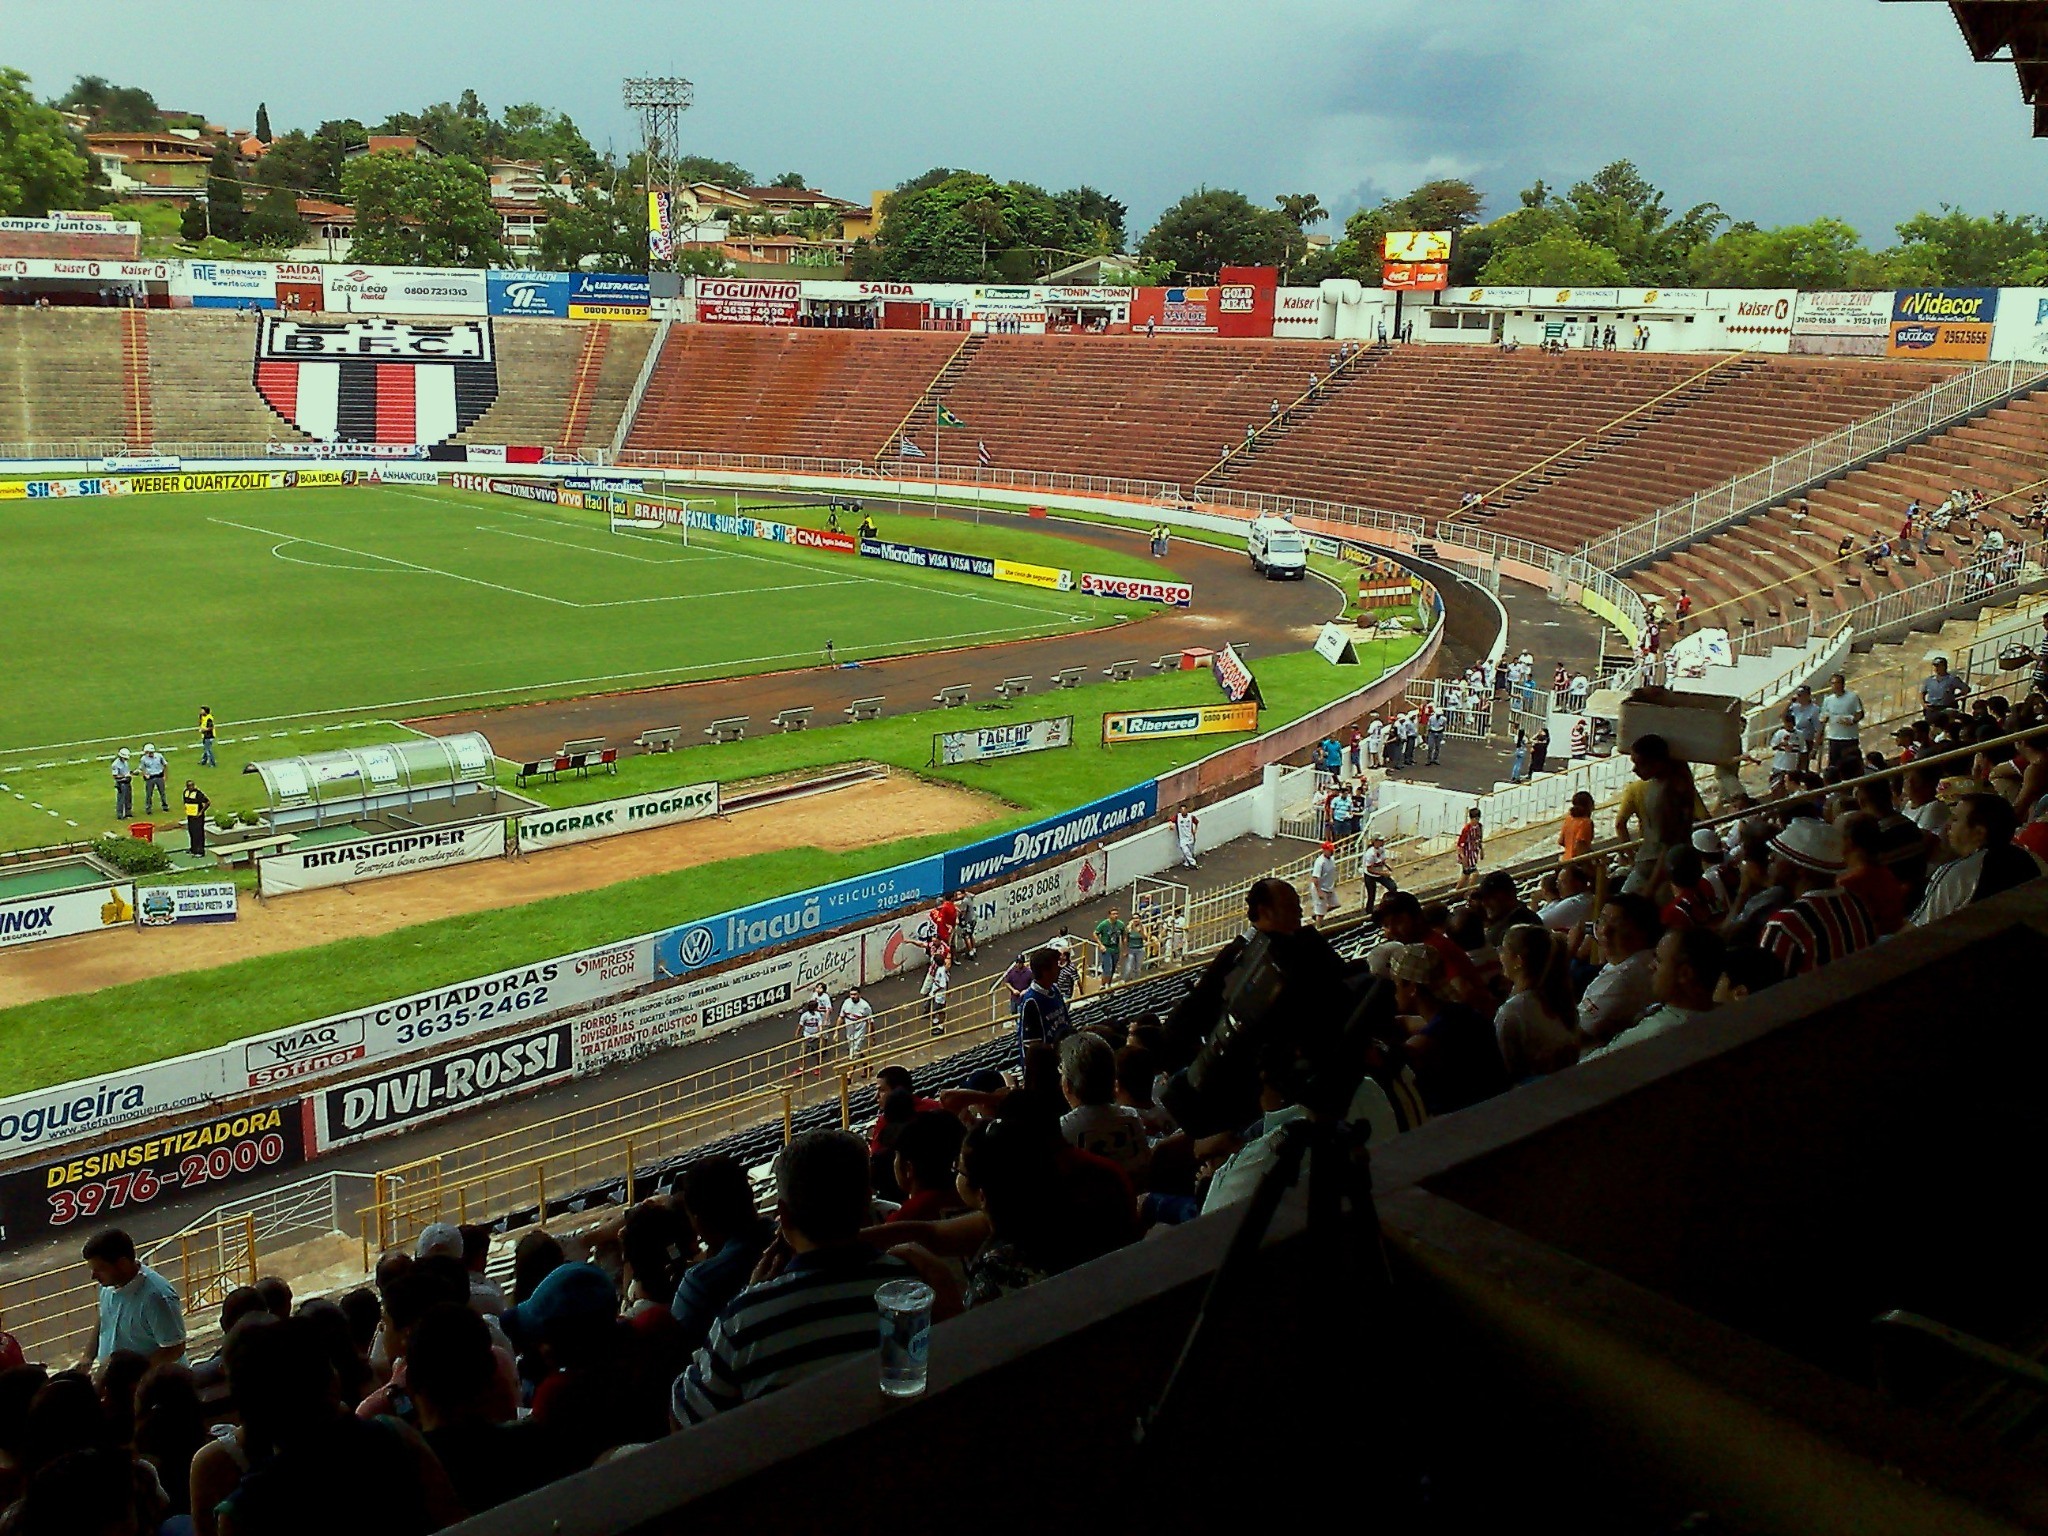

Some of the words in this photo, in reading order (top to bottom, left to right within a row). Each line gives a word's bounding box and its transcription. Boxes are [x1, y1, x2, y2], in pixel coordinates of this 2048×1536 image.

[55, 219, 107, 231] juntos.
[54, 262, 86, 274] Kaiser
[121, 265, 152, 276] Kaiser
[700, 282, 797, 299] FOGUINHO
[1283, 297, 1315, 311] Kaiser
[1913, 292, 1983, 315] Vidacor
[1737, 301, 1774, 316] Kaiser
[131, 476, 180, 493] WEBER
[183, 473, 270, 491] QUARTZOLIT
[300, 474, 317, 484] BOA
[564, 478, 591, 489] Cursos
[591, 479, 644, 493] Microlins
[452, 472, 492, 493] STECK
[535, 488, 557, 503] VIVO
[558, 491, 582, 507] VIVO
[585, 494, 602, 511] Itaú
[608, 497, 626, 514] Iaú
[634, 502, 684, 524] BRAHMA
[686, 509, 714, 531] FATAL
[797, 530, 823, 547] CNA
[860, 543, 881, 555] Cursos
[881, 543, 926, 566] Microlins
[928, 552, 949, 568] VISA
[950, 556, 971, 572] VISA
[972, 559, 993, 575] VISA
[1081, 574, 1191, 603] Savegnago
[1128, 717, 1197, 733] Ribercred
[627, 790, 713, 821] ITOGRASS
[520, 808, 615, 840] ITOGRASS
[302, 829, 466, 870] BRASCOPPER
[354, 855, 395, 876] Energia
[1009, 883, 1034, 906] 3623
[727, 895, 821, 951] Itacuã
[829, 879, 896, 907] VEICULOS
[2, 929, 48, 941] SEGURANÇA
[600, 962, 635, 981] RICOH
[796, 949, 851, 986] Facility
[375, 963, 559, 1026] COPIADORAS
[396, 986, 550, 1044] 3635-2462
[580, 1012, 618, 1032] FORROS
[580, 1019, 635, 1044] DIVISÓRIAS
[581, 1028, 649, 1057] TRATAMENTO
[651, 1012, 698, 1036] ACÚSTICO
[257, 1048, 357, 1086] Soffner
[342, 1031, 562, 1131] DIVI-ROSSI
[0, 1082, 145, 1143] ogueira
[49, 1089, 214, 1140] www.stefaninogueira.com.br
[47, 1108, 282, 1188] DESINSETIZADORA
[49, 1132, 285, 1226] 3976-2000
